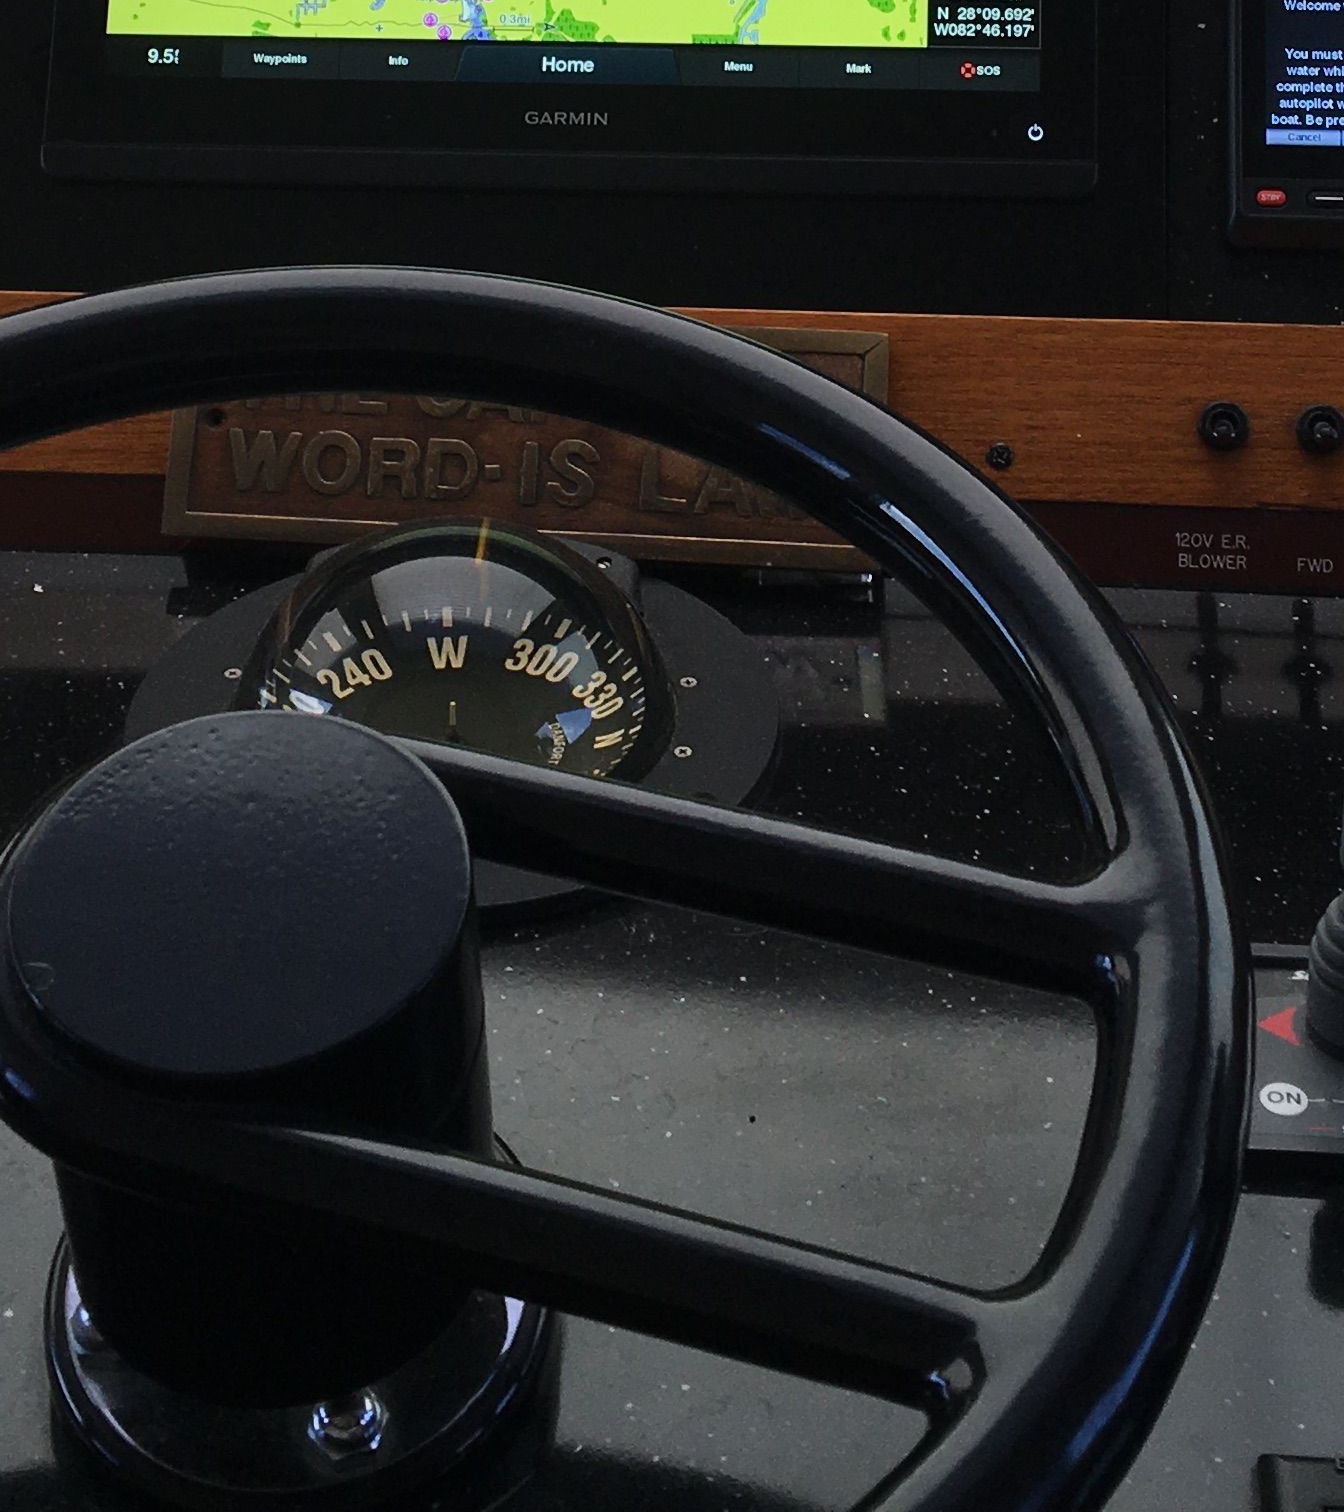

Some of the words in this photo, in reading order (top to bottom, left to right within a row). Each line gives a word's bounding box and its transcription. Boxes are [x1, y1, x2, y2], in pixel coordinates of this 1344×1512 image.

[937, 7, 949, 20] N
[1284, 0, 1341, 12] Welcome
[253, 52, 307, 65] Waypoints
[388, 55, 408, 67] Info
[1285, 49, 1308, 60] You
[1312, 50, 1343, 60] must
[542, 56, 595, 73] Home
[724, 61, 753, 72] Menu
[846, 63, 872, 74] Mark
[976, 65, 1000, 75] SOS
[525, 110, 608, 126] GARMIN
[1175, 532, 1213, 549] 120V
[1221, 533, 1250, 550] E.R.
[1178, 552, 1247, 570] BLOWER
[1297, 558, 1333, 574] FWD
[427, 635, 468, 669] W
[505, 638, 578, 683] 300
[317, 649, 392, 698] 240
[573, 671, 625, 720] 330
[1267, 1091, 1302, 1105] ON
